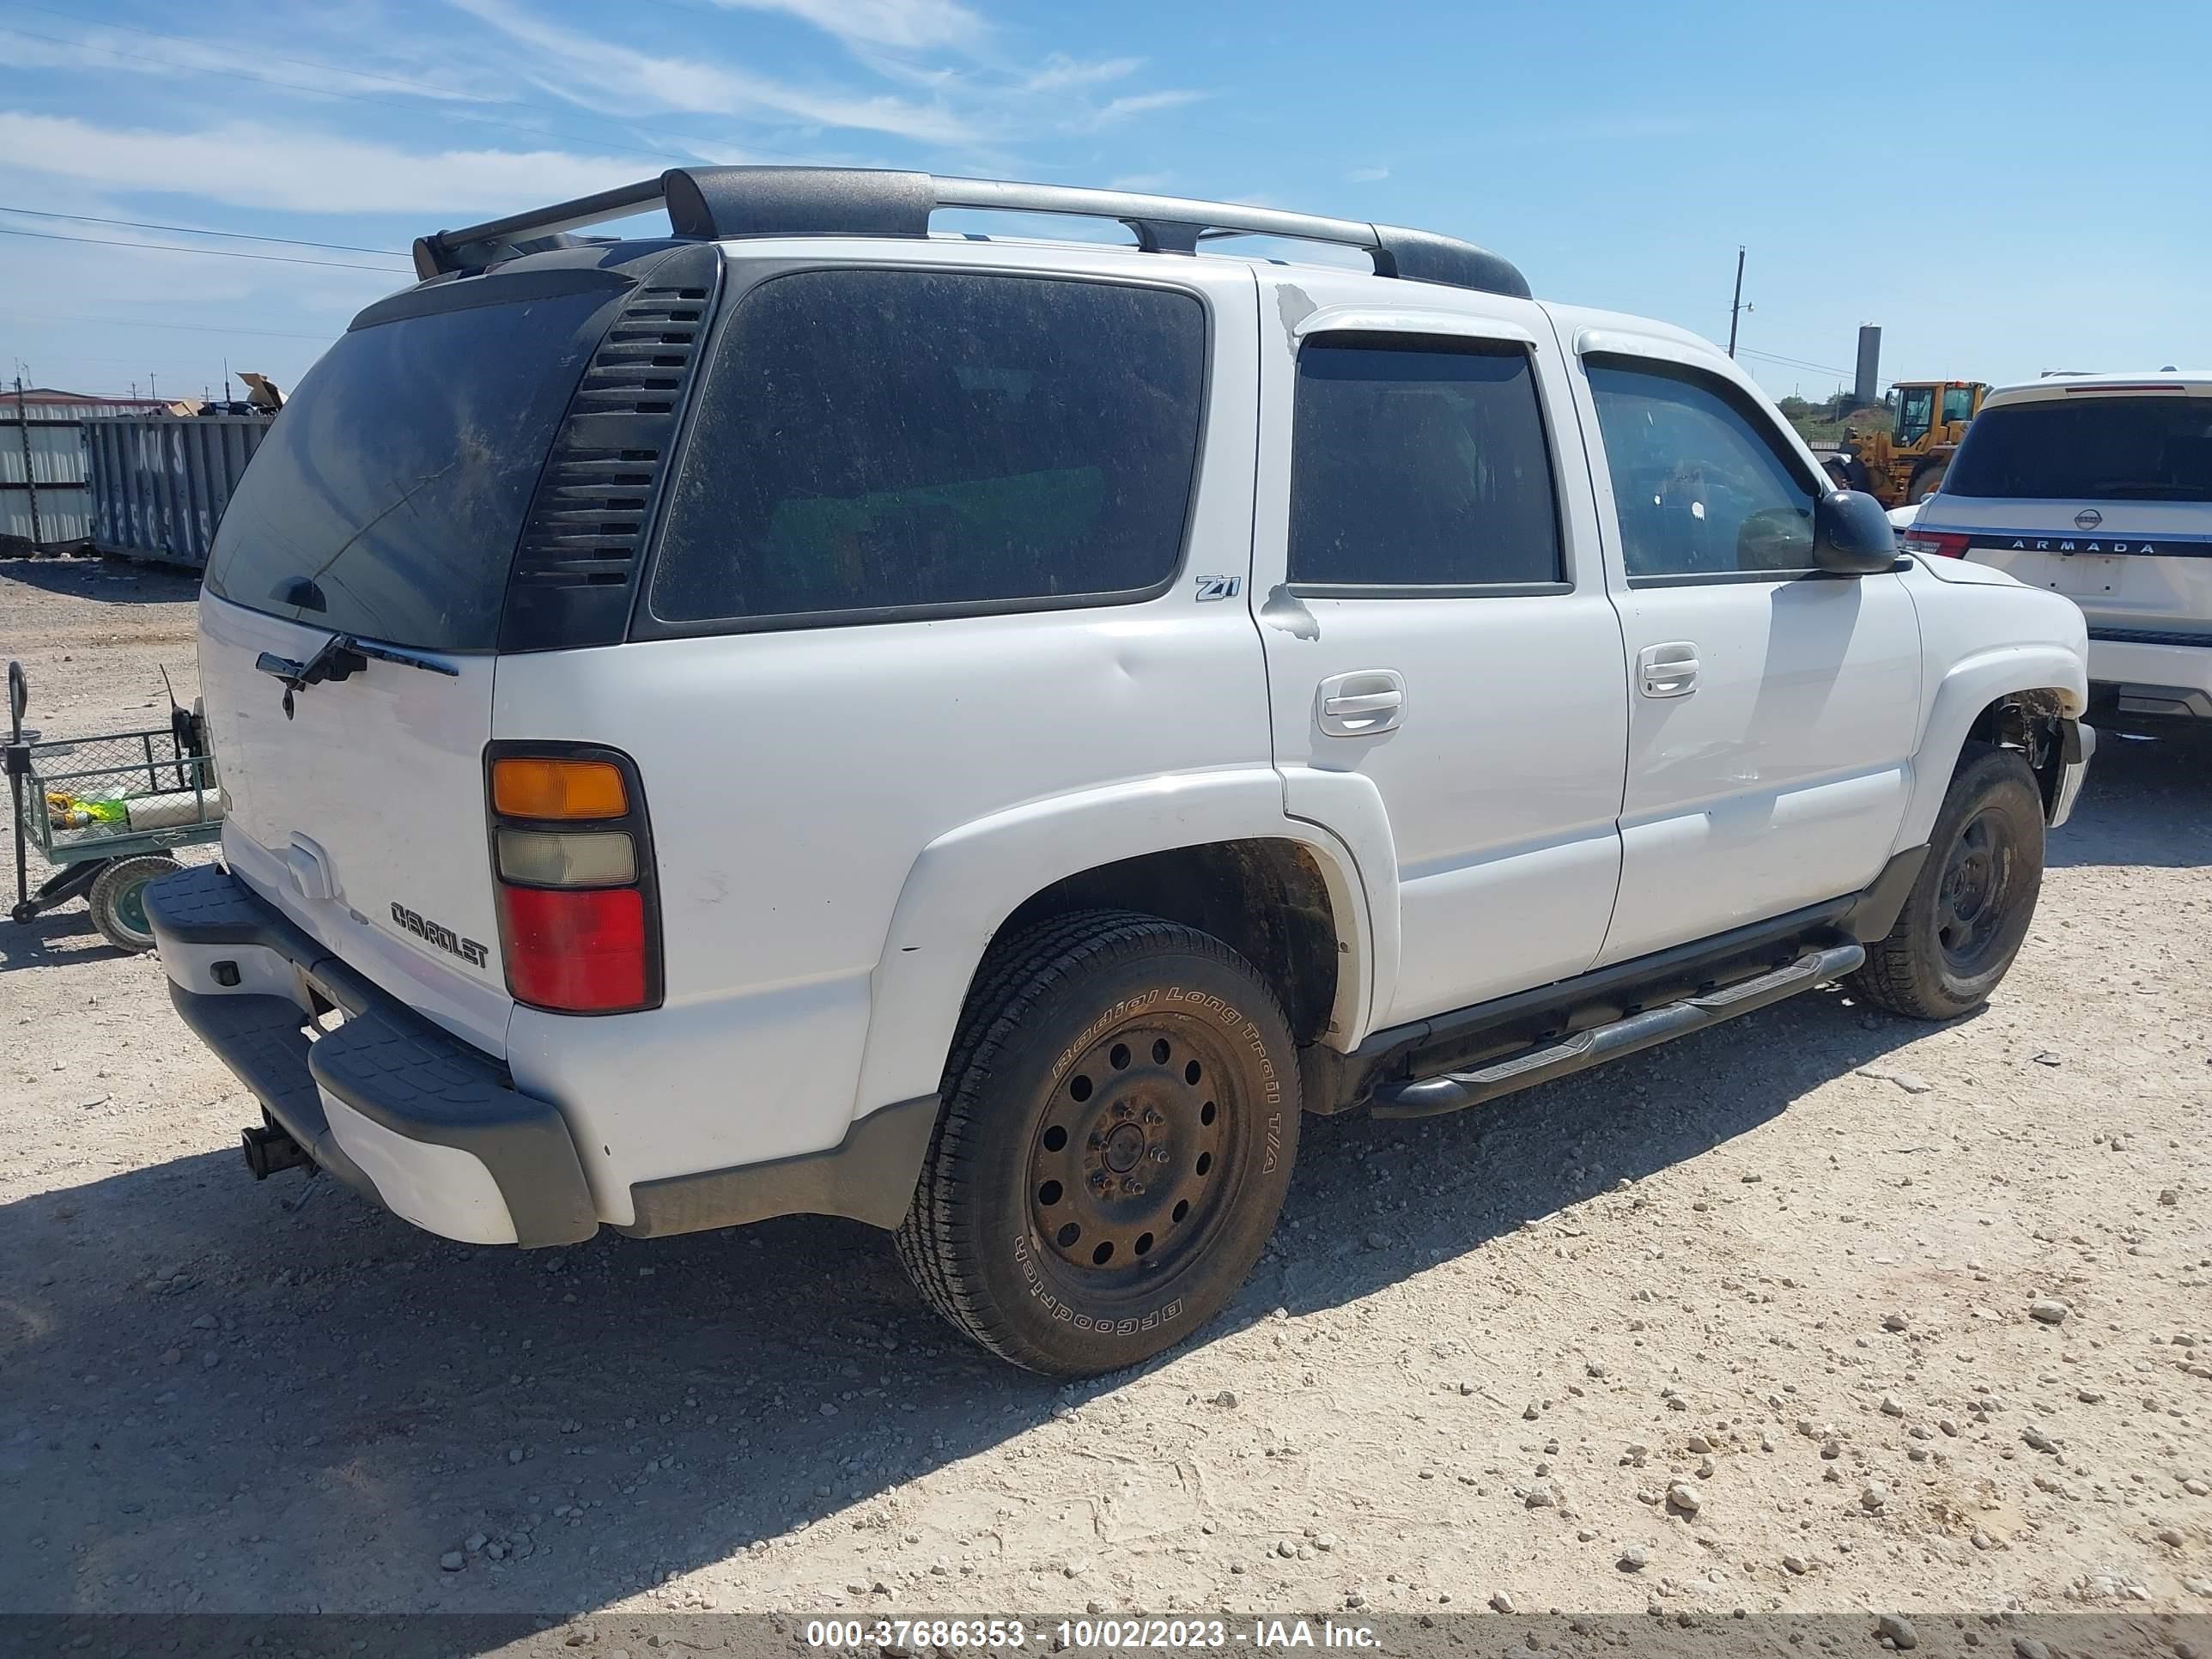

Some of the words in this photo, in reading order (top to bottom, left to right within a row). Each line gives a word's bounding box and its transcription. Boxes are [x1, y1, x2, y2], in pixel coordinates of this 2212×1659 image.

[2012, 539, 2154, 554] ARMADA
[1195, 575, 1242, 602] Z71
[1052, 988, 1159, 1079] Radial
[1165, 987, 1242, 1025] Long
[1243, 1022, 1280, 1103] Trail
[1262, 1112, 1282, 1175] T/A
[1014, 1235, 1182, 1336] BFGoodrich
